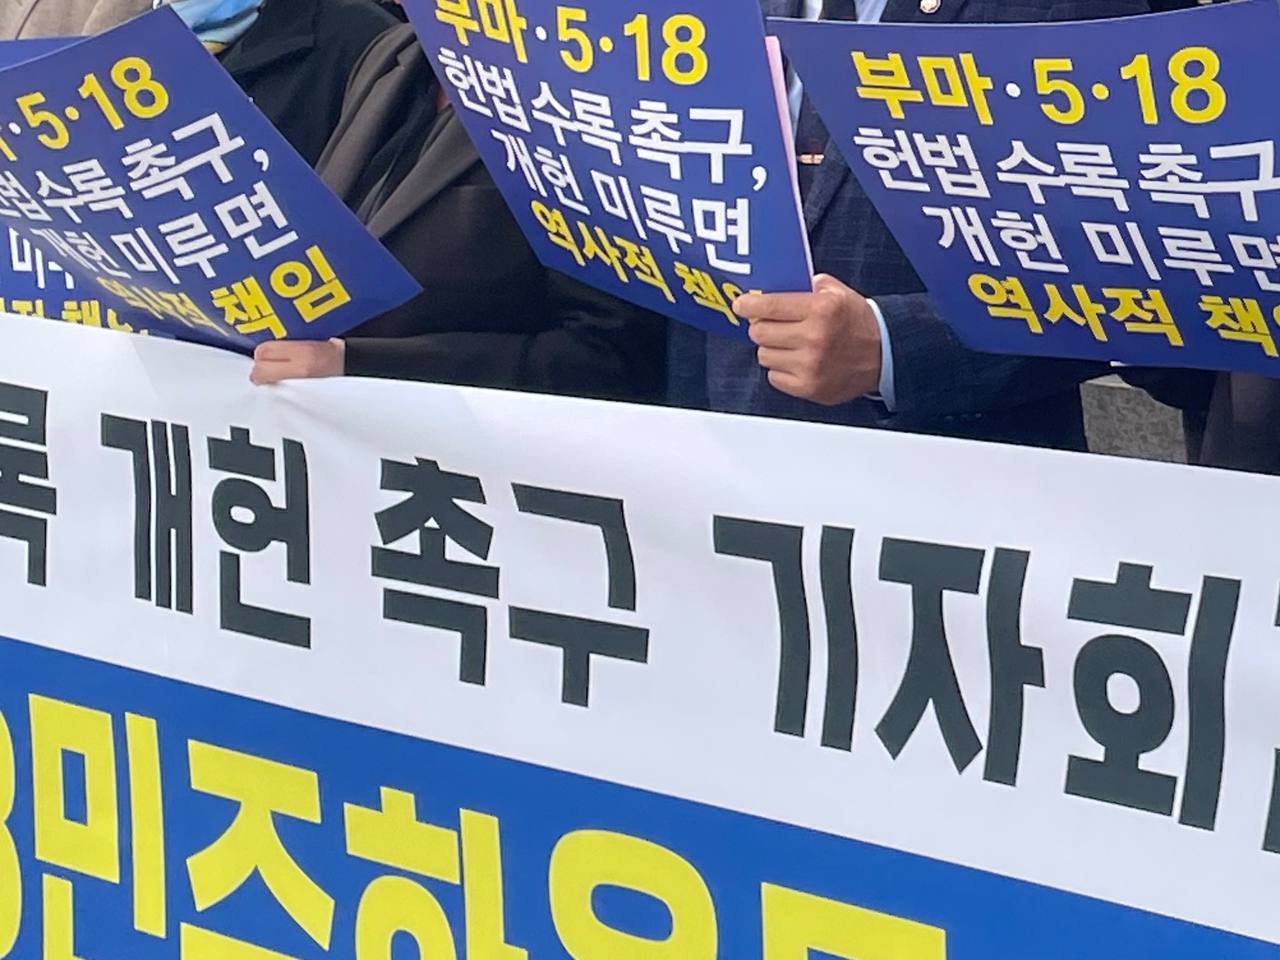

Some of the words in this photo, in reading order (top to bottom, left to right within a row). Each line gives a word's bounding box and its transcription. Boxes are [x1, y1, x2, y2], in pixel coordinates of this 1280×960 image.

[0, 56, 169, 161] ·5·18
[437, 47, 532, 133] 헌법
[531, 81, 622, 166] 수록
[627, 100, 768, 191] 촉구,
[850, 46, 1228, 127] 부마·5·18
[36, 159, 134, 224] 수록
[121, 112, 270, 200] 촉구,
[491, 129, 590, 215] 개헌
[589, 168, 752, 275] 미루면
[852, 126, 991, 199] 헌법
[996, 139, 1131, 212] 수록
[110, 180, 299, 284] 미루면
[531, 199, 676, 303] 역사적
[923, 205, 1069, 275] 개헌
[211, 245, 352, 340] 책임
[966, 272, 1185, 348] 역사적
[100, 412, 311, 649] 개헌
[371, 456, 650, 707] 촉구
